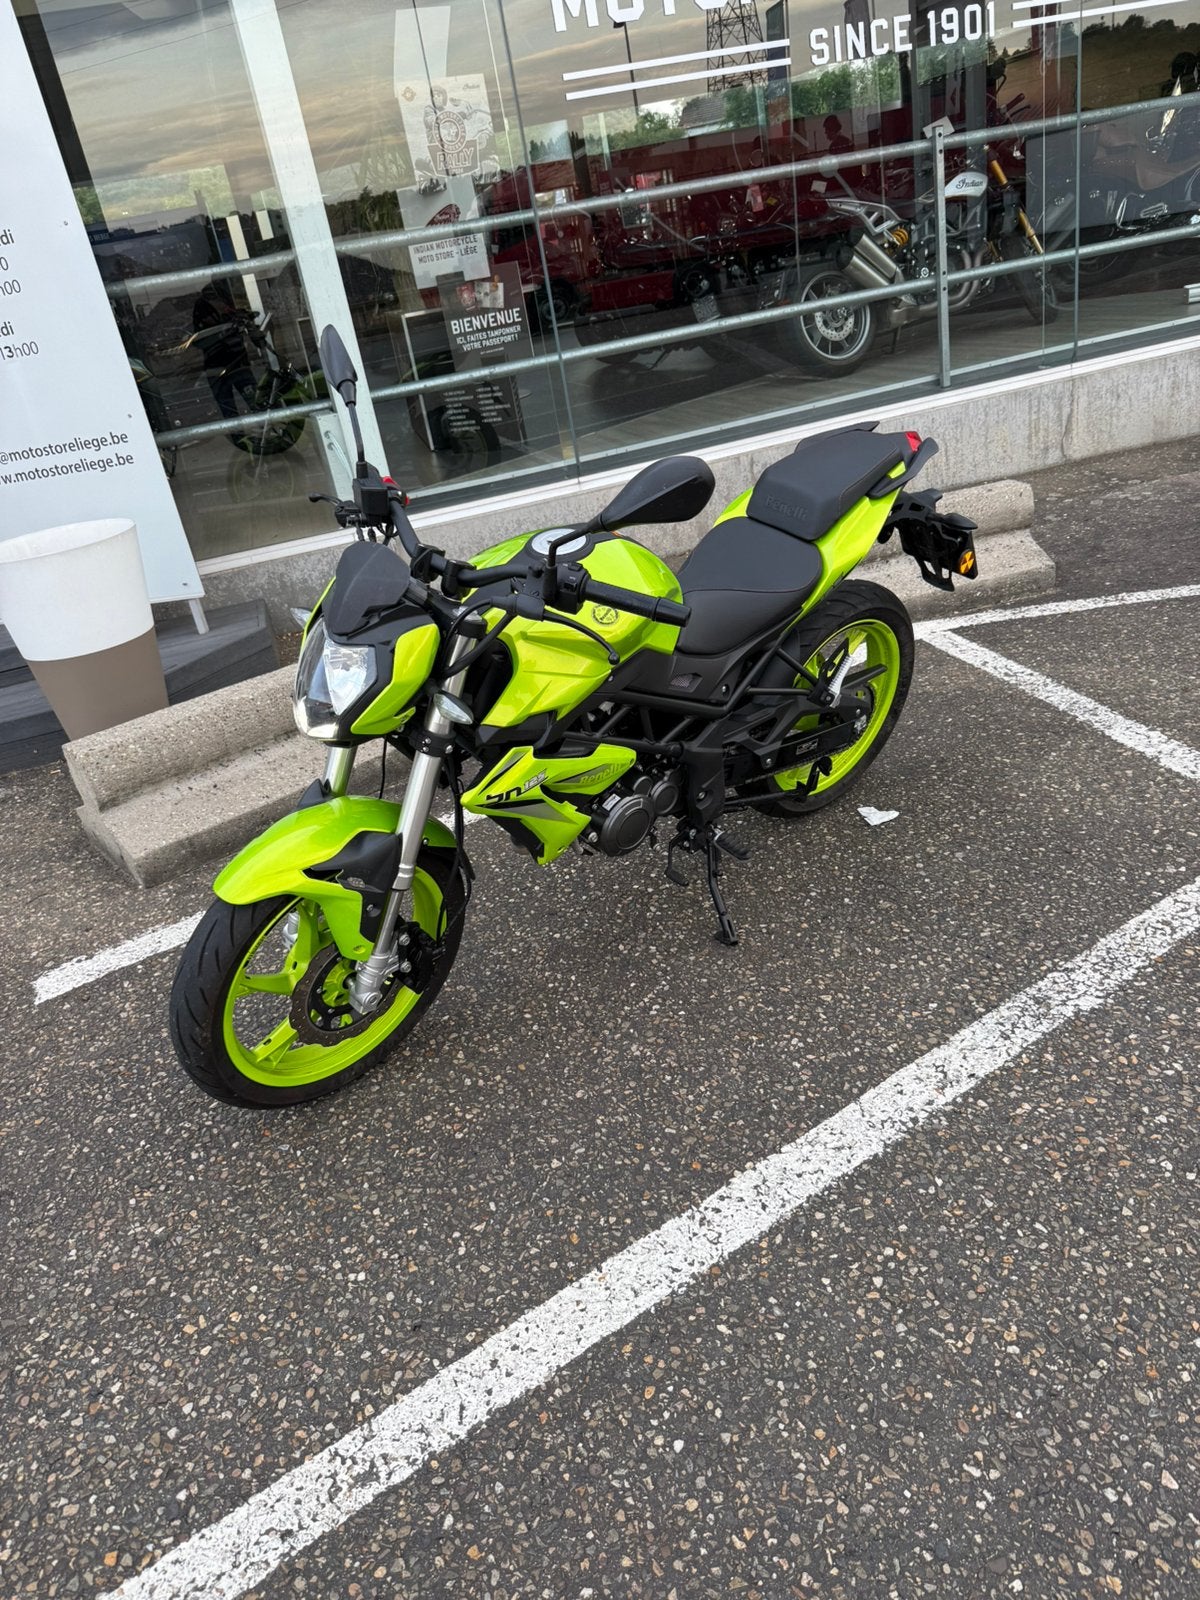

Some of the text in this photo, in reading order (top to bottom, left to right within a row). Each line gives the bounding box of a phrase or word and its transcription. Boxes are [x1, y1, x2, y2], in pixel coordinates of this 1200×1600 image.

[809, 15, 913, 66] SINCE
[927, 3, 996, 46] 1901
[436, 147, 475, 171] RALLY
[955, 177, 984, 190] Indian
[0, 228, 15, 246] di
[435, 234, 479, 251] MOTORCYCLE
[417, 254, 435, 264] MOTO
[435, 250, 455, 262] STORE
[0, 321, 15, 337] di
[450, 307, 522, 335] BIENVENUE
[466, 331, 488, 342] FAITES
[487, 324, 521, 338] TAMPONNER
[462, 341, 482, 352] VOTRE
[482, 334, 515, 347] PASSEPORT
[0, 452, 135, 485] w.motostoreliege.be
